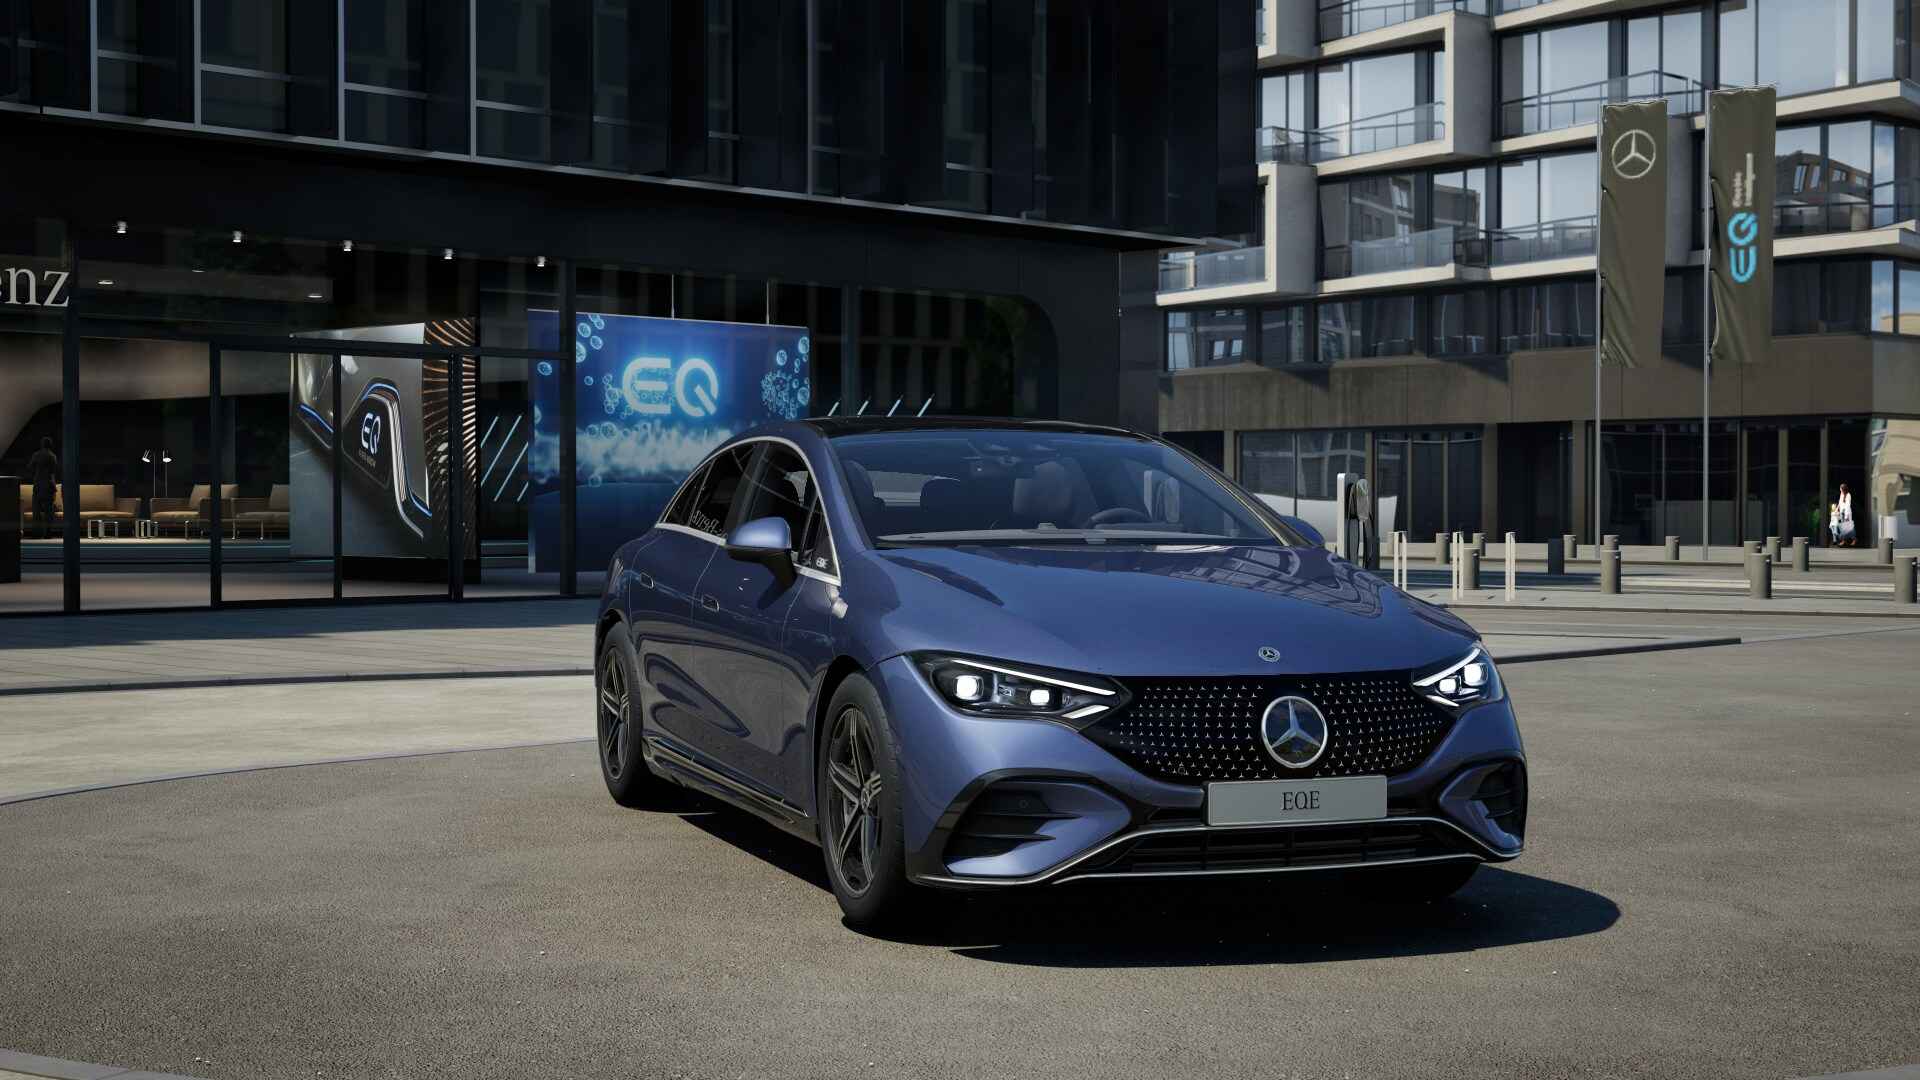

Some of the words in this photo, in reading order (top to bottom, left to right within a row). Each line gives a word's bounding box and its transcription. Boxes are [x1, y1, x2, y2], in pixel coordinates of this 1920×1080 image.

[1726, 211, 1758, 283] EQ
[0, 267, 70, 307] nz
[622, 356, 719, 417] EQ
[361, 412, 381, 455] EQ
[1281, 790, 1321, 811] EQE
